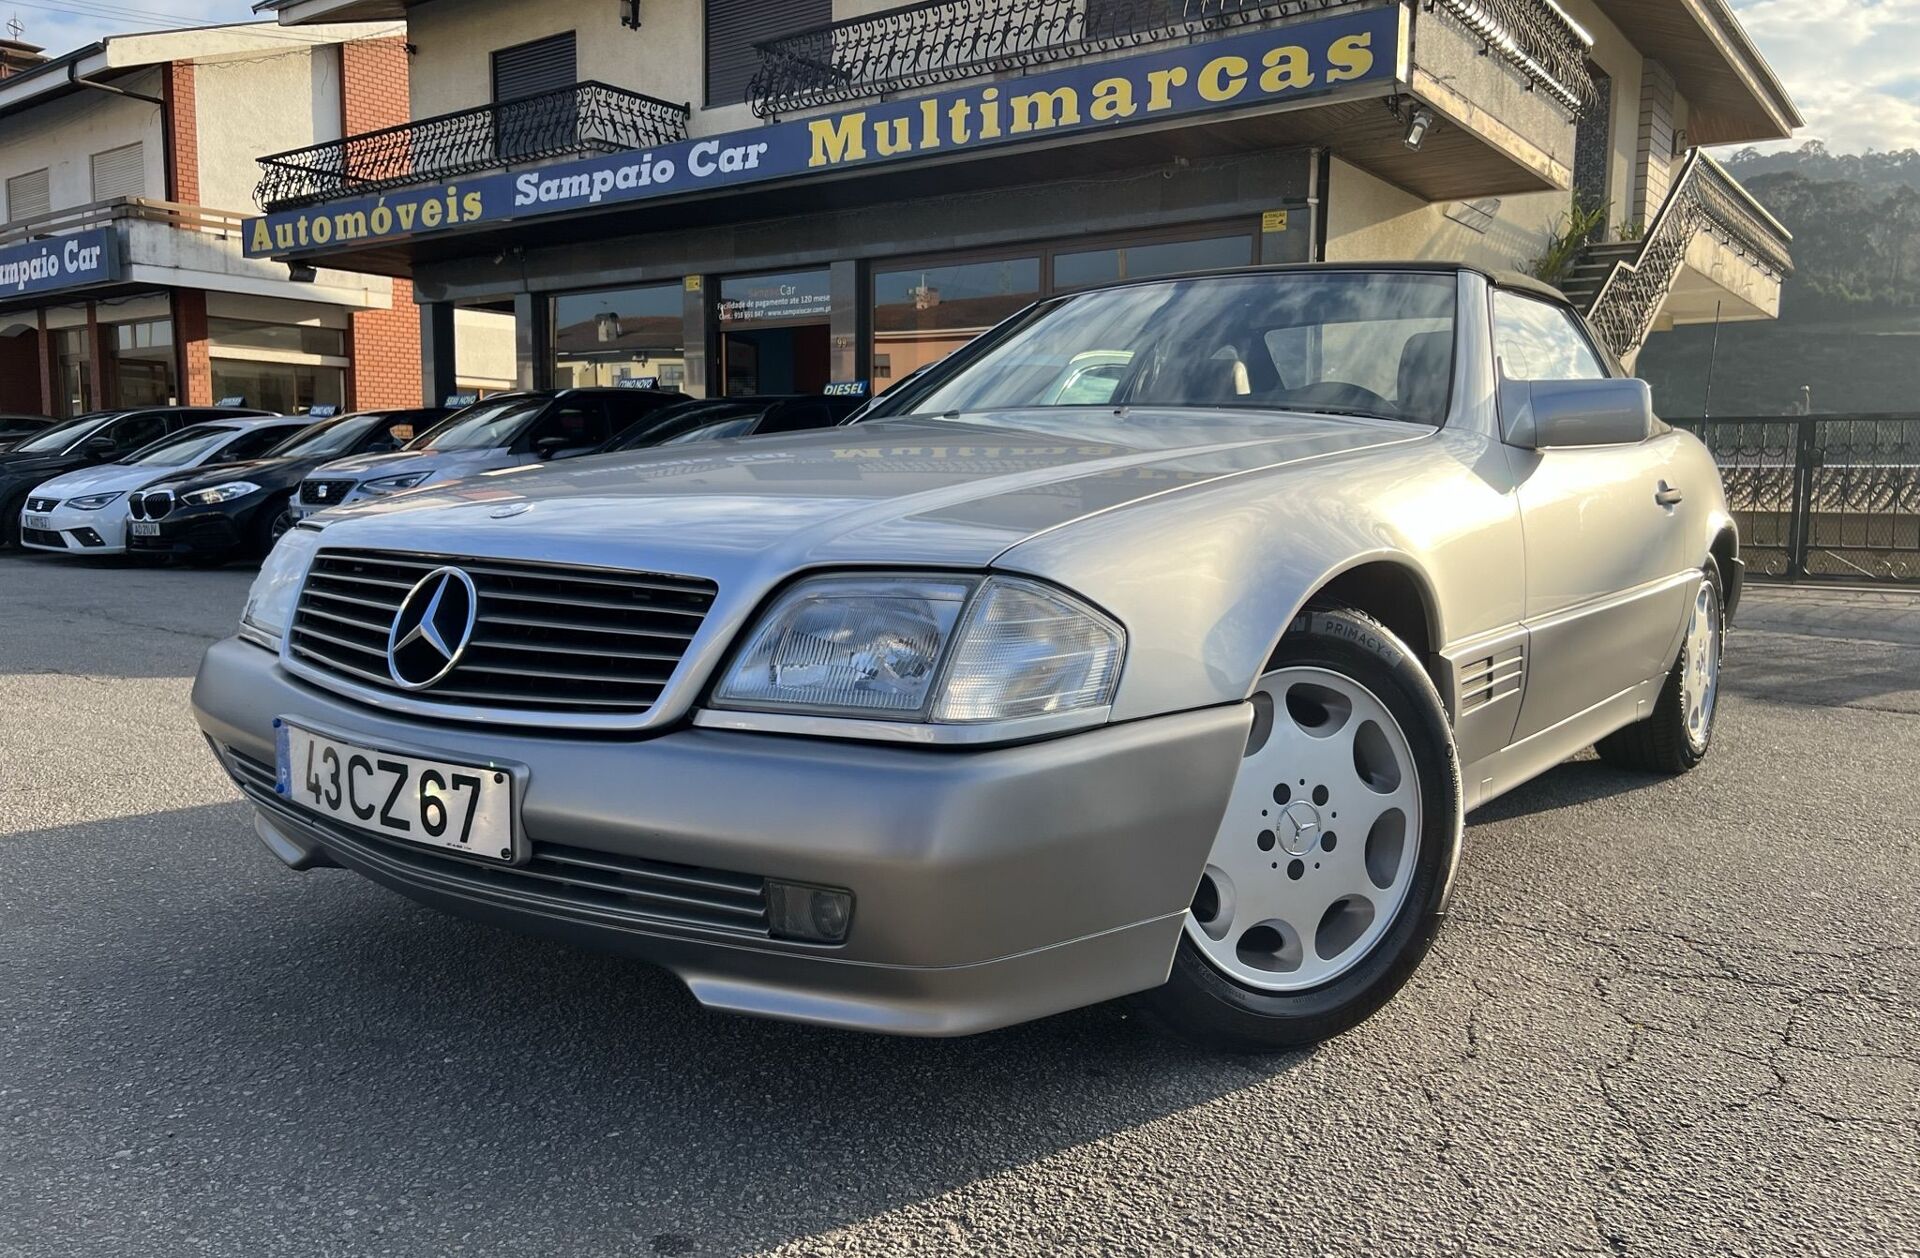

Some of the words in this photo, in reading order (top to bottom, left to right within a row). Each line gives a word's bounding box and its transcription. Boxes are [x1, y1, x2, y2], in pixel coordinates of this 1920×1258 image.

[251, 186, 483, 251] Automóveis
[515, 154, 675, 206] Sampaio
[688, 140, 768, 177] Car
[807, 32, 1374, 168] Multimarcas
[64, 240, 100, 273] Car
[755, 298, 788, 309] pagamento
[813, 294, 831, 303] mese
[780, 284, 796, 296] Car
[824, 383, 863, 396] DIESEL
[1325, 621, 1385, 652] PRIMACY
[306, 740, 480, 844] 43CZ67
